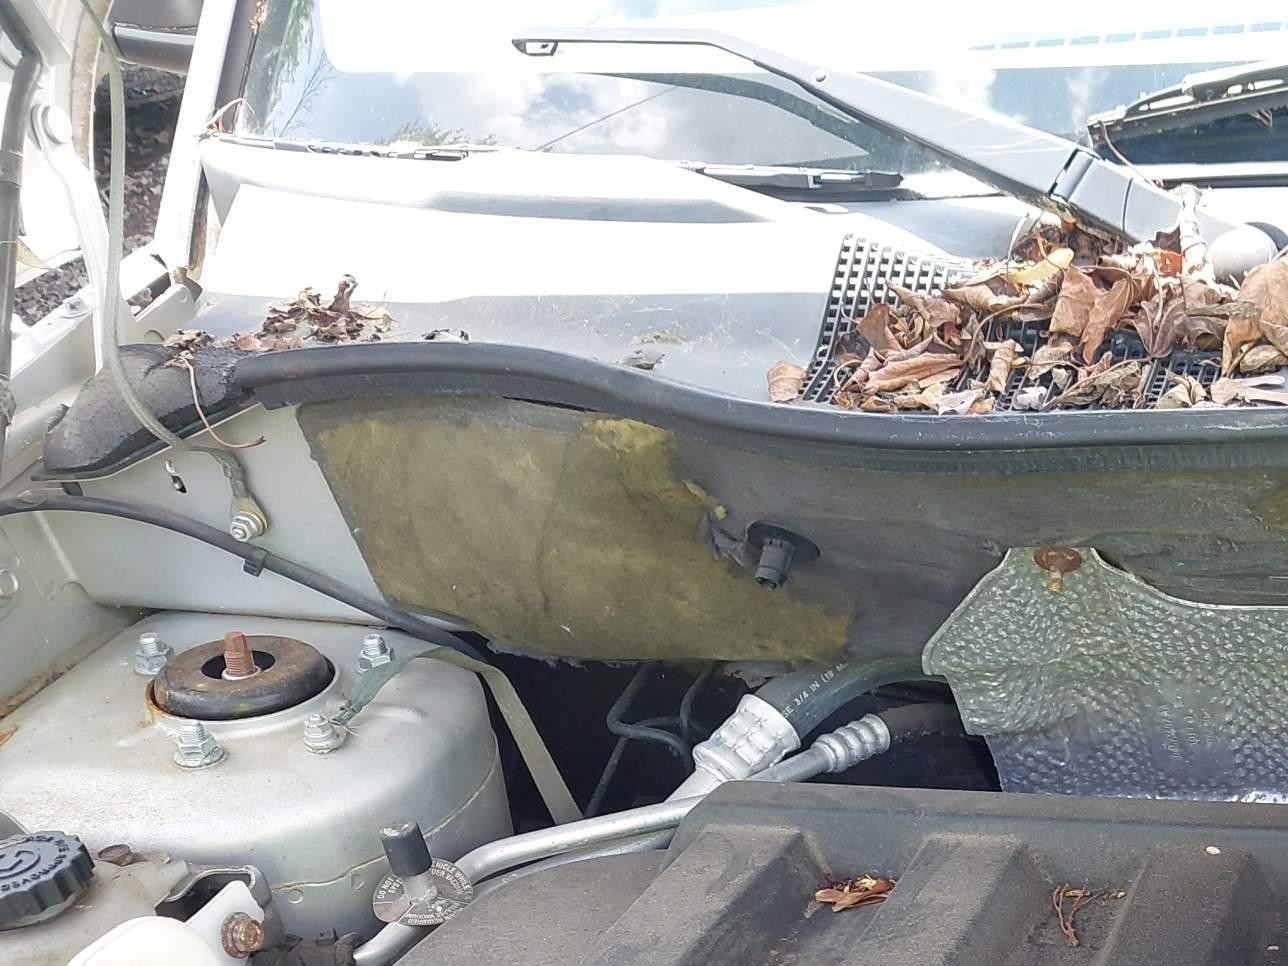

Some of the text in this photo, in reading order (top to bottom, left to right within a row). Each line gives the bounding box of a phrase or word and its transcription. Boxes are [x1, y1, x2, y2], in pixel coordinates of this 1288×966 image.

[809, 680, 820, 692] IN
[377, 860, 471, 898] DO NOT EHICLE WHILE
